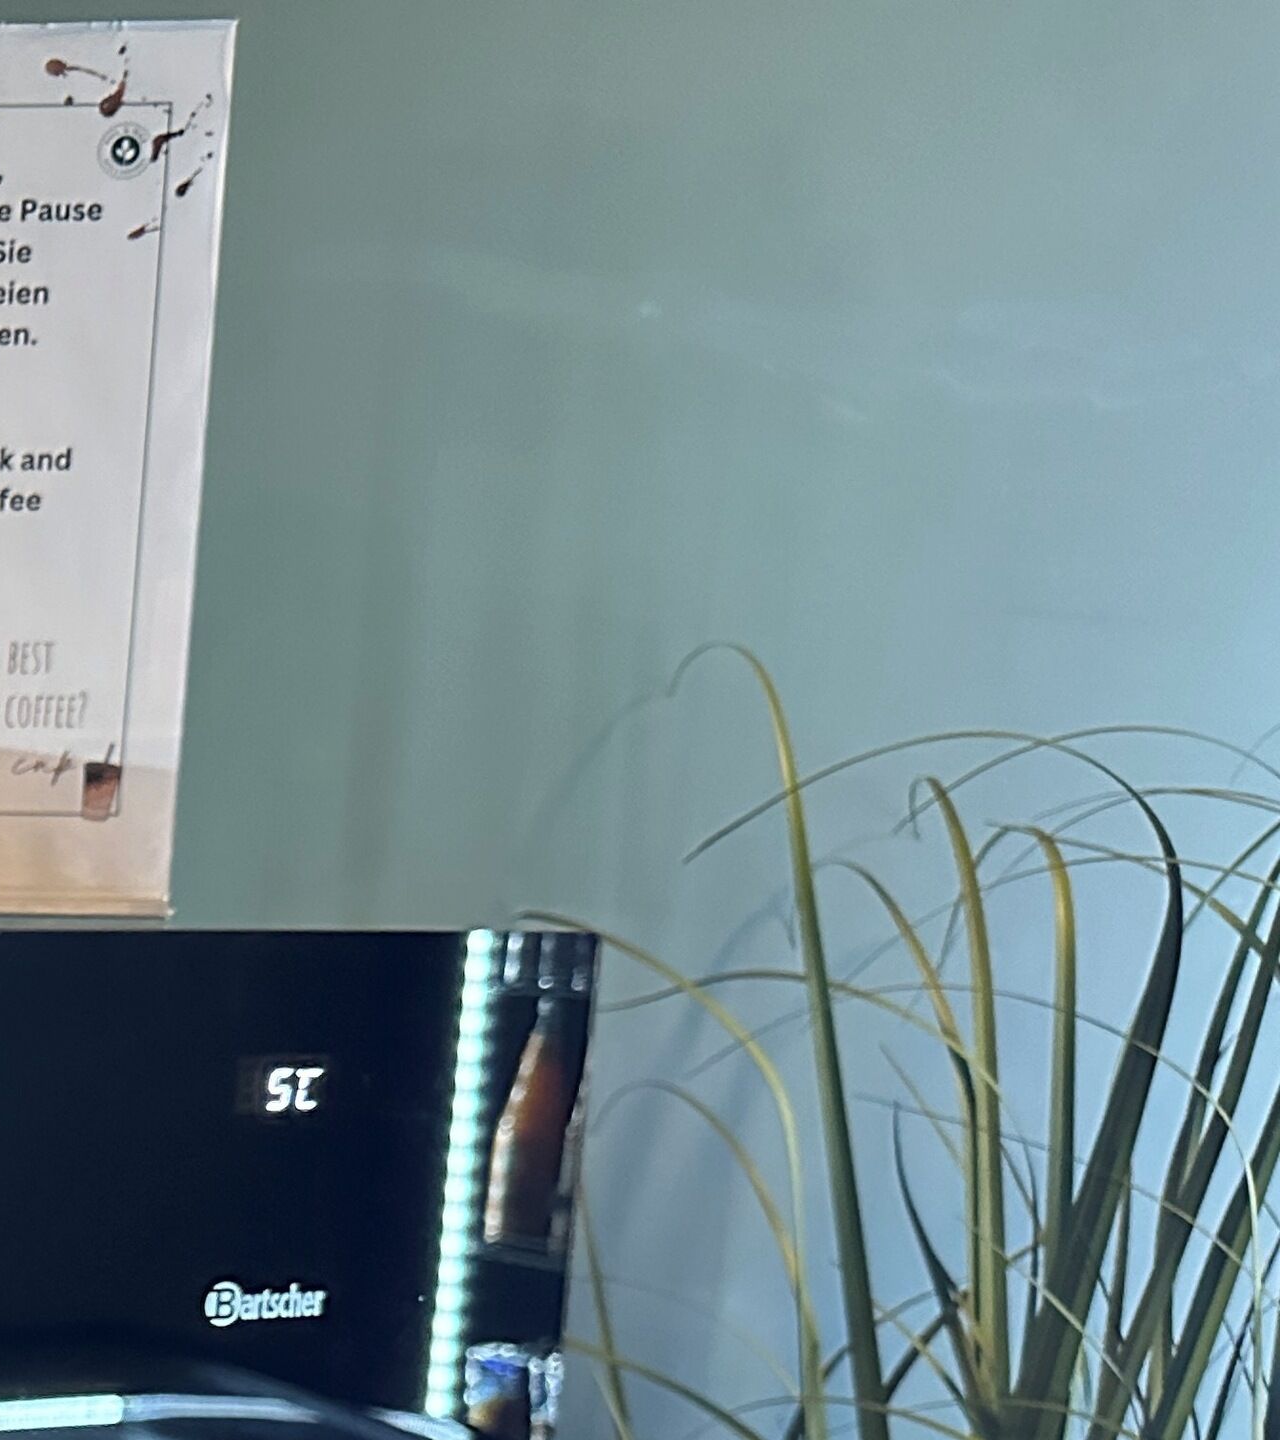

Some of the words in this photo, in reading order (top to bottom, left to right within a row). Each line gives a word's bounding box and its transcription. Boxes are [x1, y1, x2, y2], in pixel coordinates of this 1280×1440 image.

[19, 198, 104, 224] Pause
[19, 447, 73, 474] and
[6, 640, 56, 677] BEST
[204, 1280, 328, 1327] Bartscher
